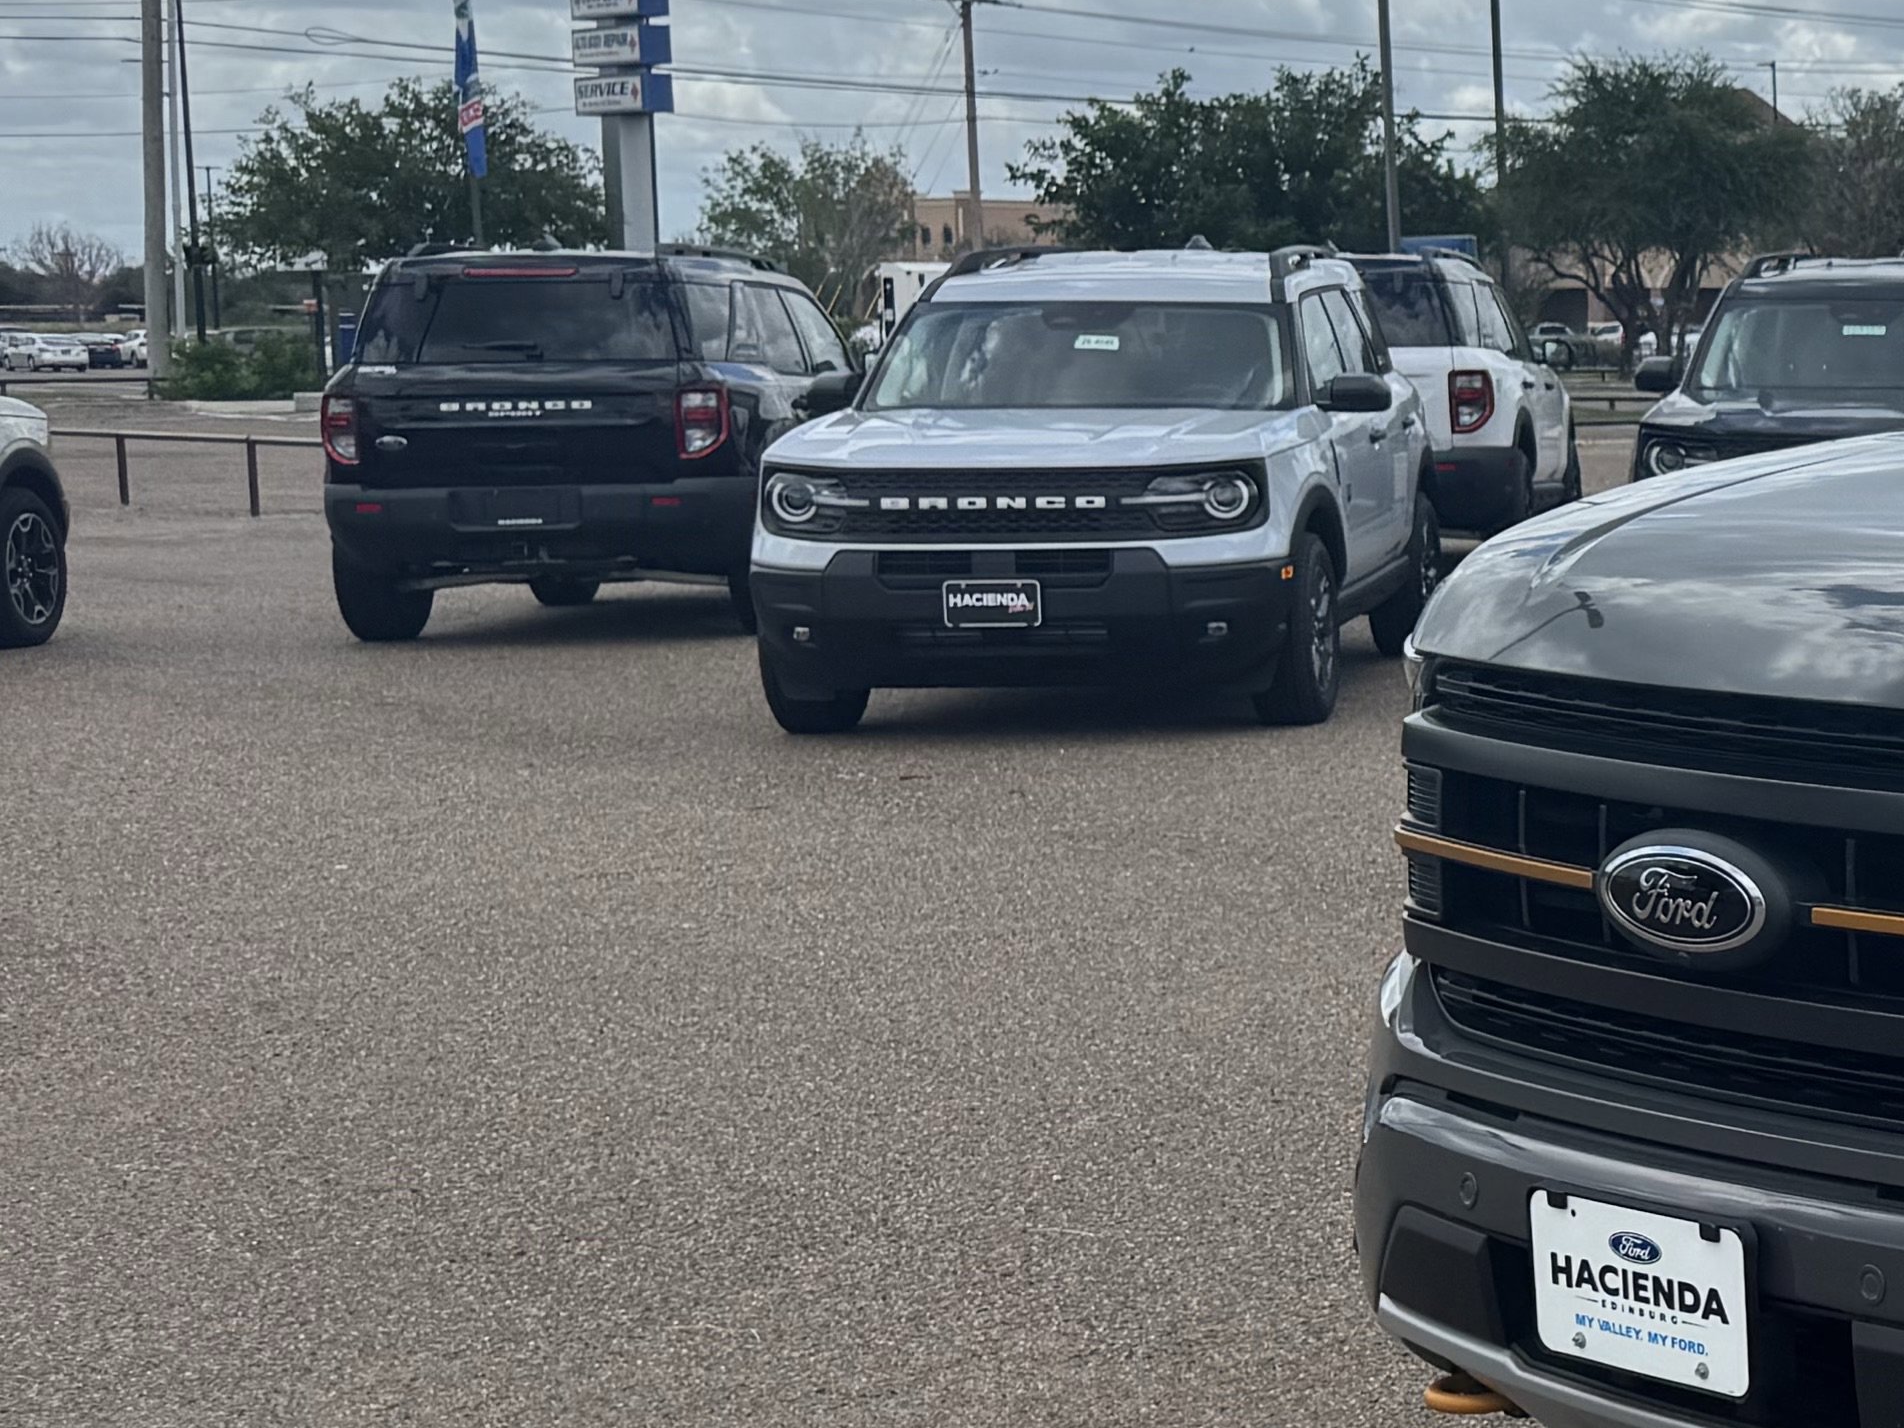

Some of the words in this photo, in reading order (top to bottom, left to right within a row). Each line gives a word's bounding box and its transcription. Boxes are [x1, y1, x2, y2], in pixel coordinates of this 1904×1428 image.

[577, 81, 629, 99] SERVICE
[440, 400, 592, 411] BRONCO
[880, 496, 1106, 510] BRONCO
[948, 593, 1029, 607] HACIENDA
[1632, 867, 1719, 929] Ford
[1619, 1236, 1651, 1260] Ford
[1550, 1251, 1730, 1325] HACIENDA
[1601, 1299, 1678, 1325] EDINBURG
[1575, 1313, 1595, 1328] MY
[1597, 1318, 1643, 1341] VALLEY.
[1647, 1331, 1668, 1346] MY
[1671, 1336, 1709, 1356] FORD.
